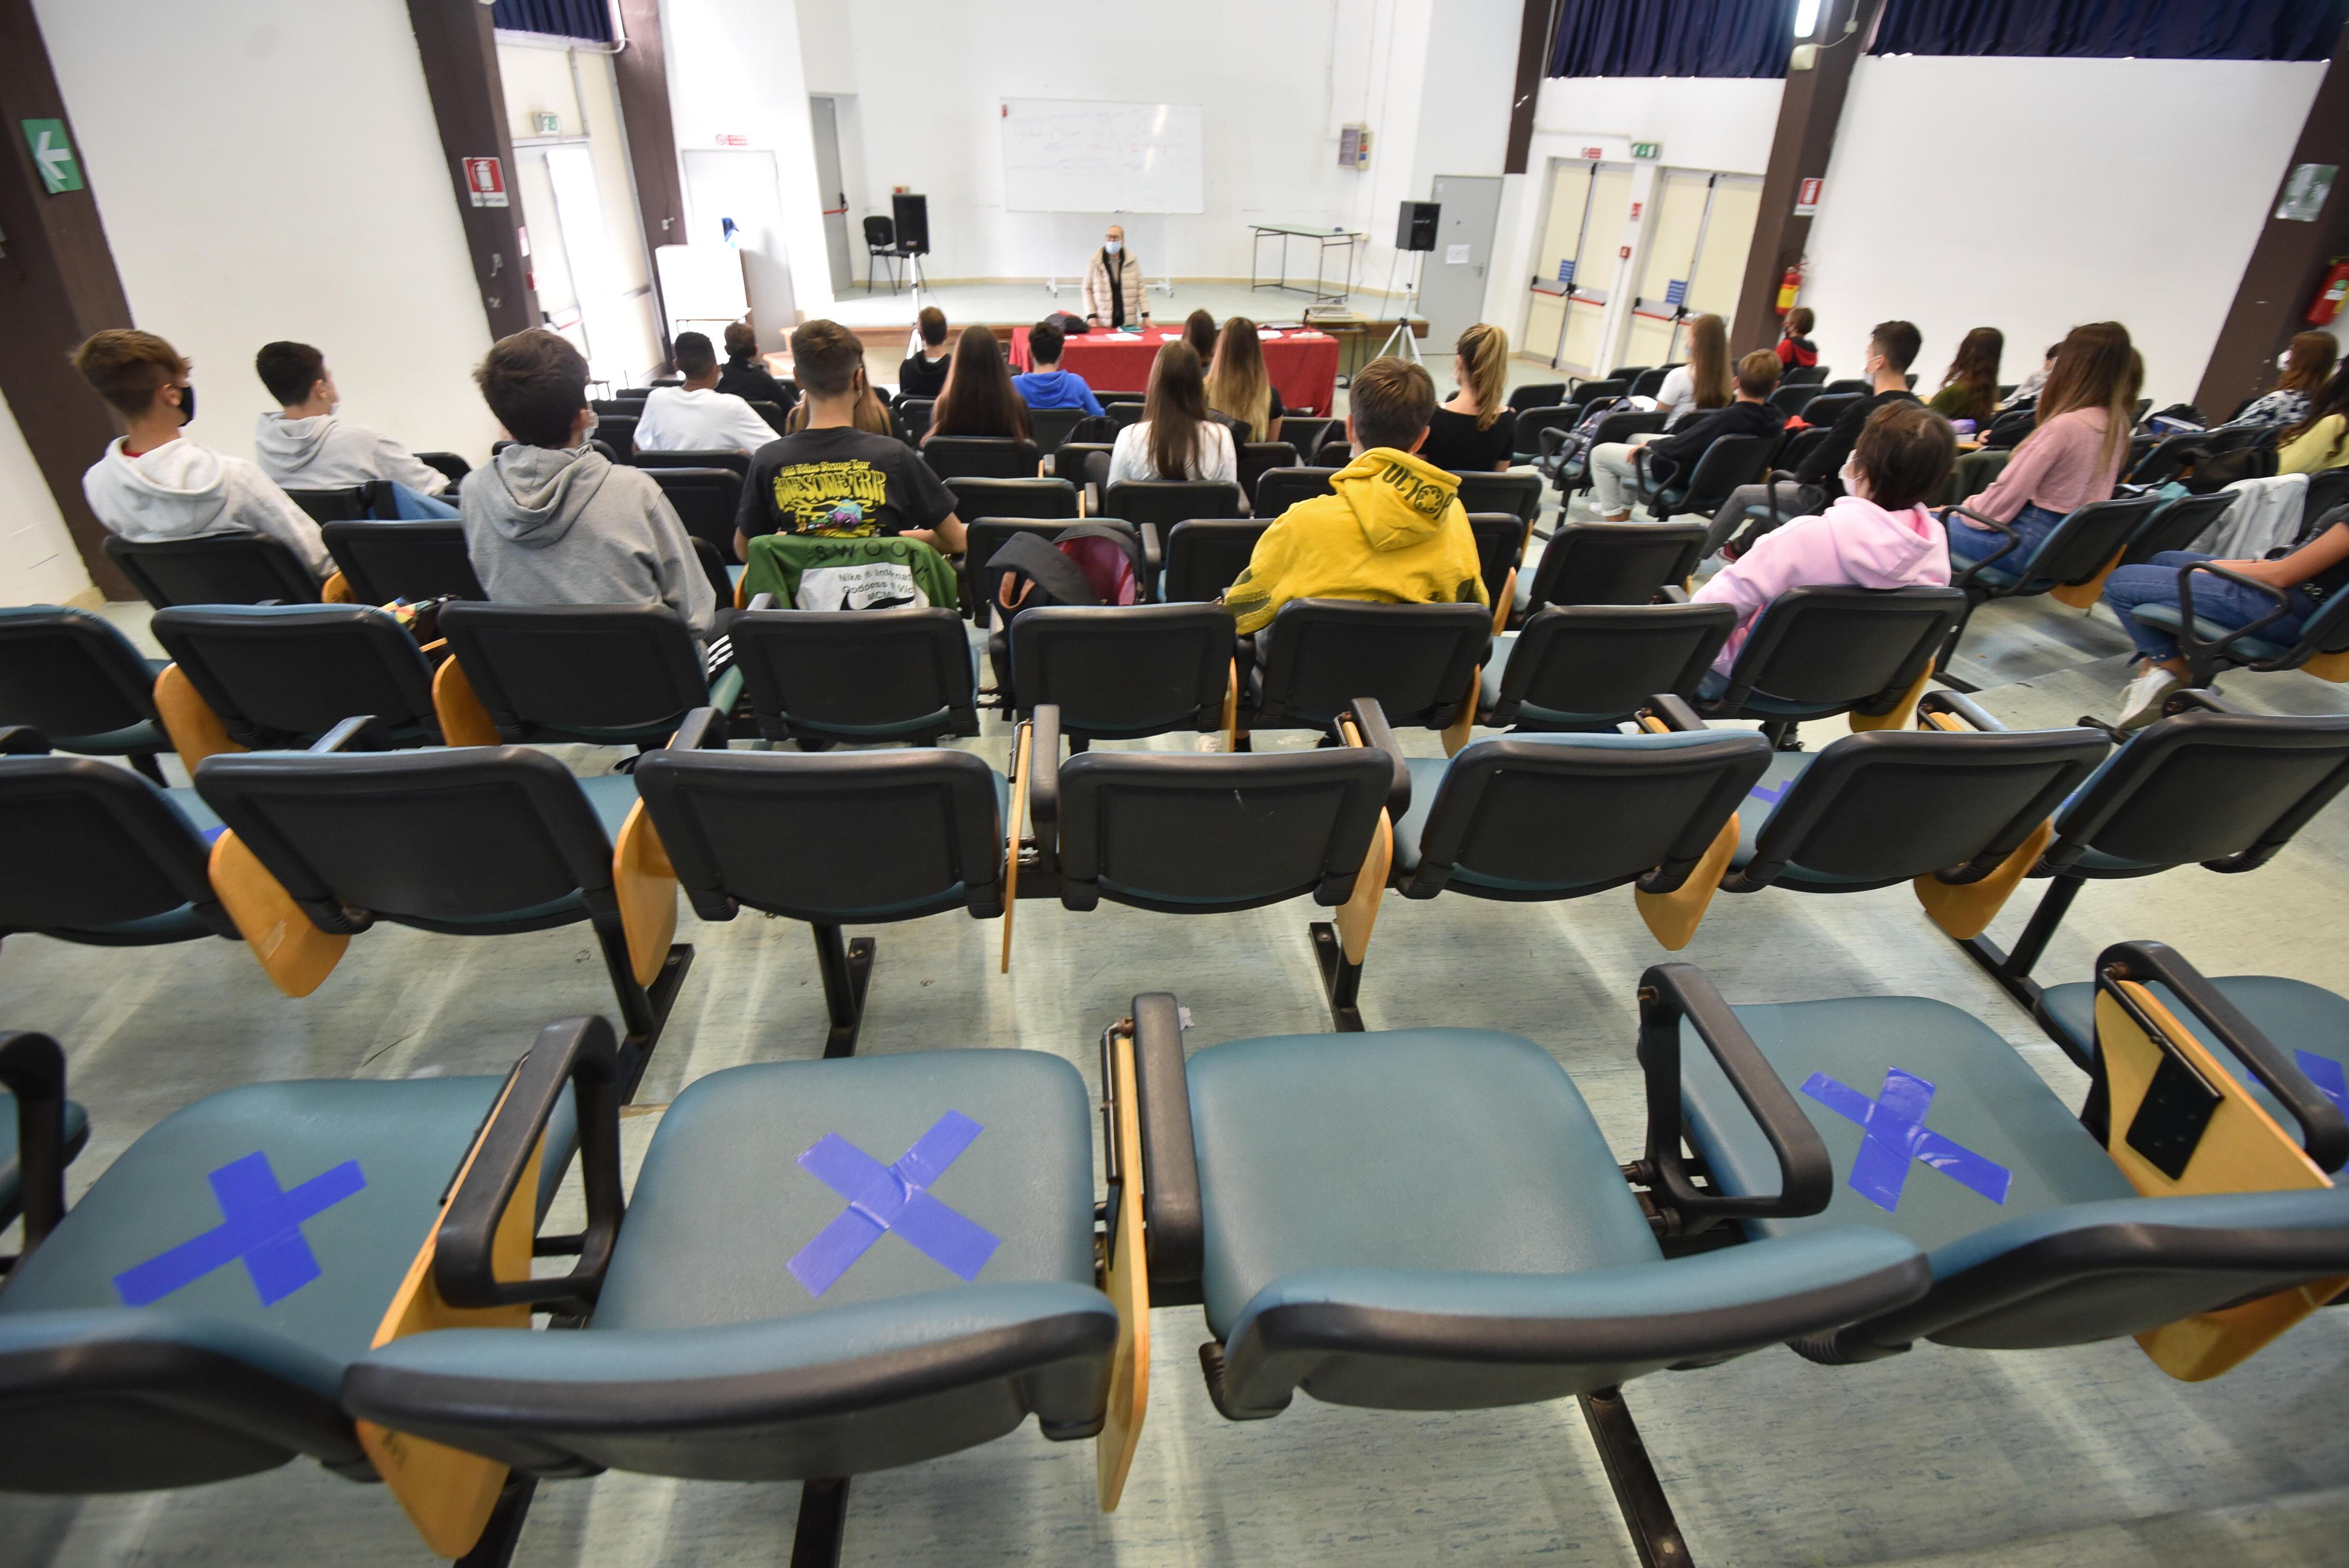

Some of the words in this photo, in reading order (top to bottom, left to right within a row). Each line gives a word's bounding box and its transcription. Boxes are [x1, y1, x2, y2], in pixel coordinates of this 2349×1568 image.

[850, 459, 871, 470] Tour
[848, 469, 887, 506] TRIP
[842, 580, 888, 594] Goddess
